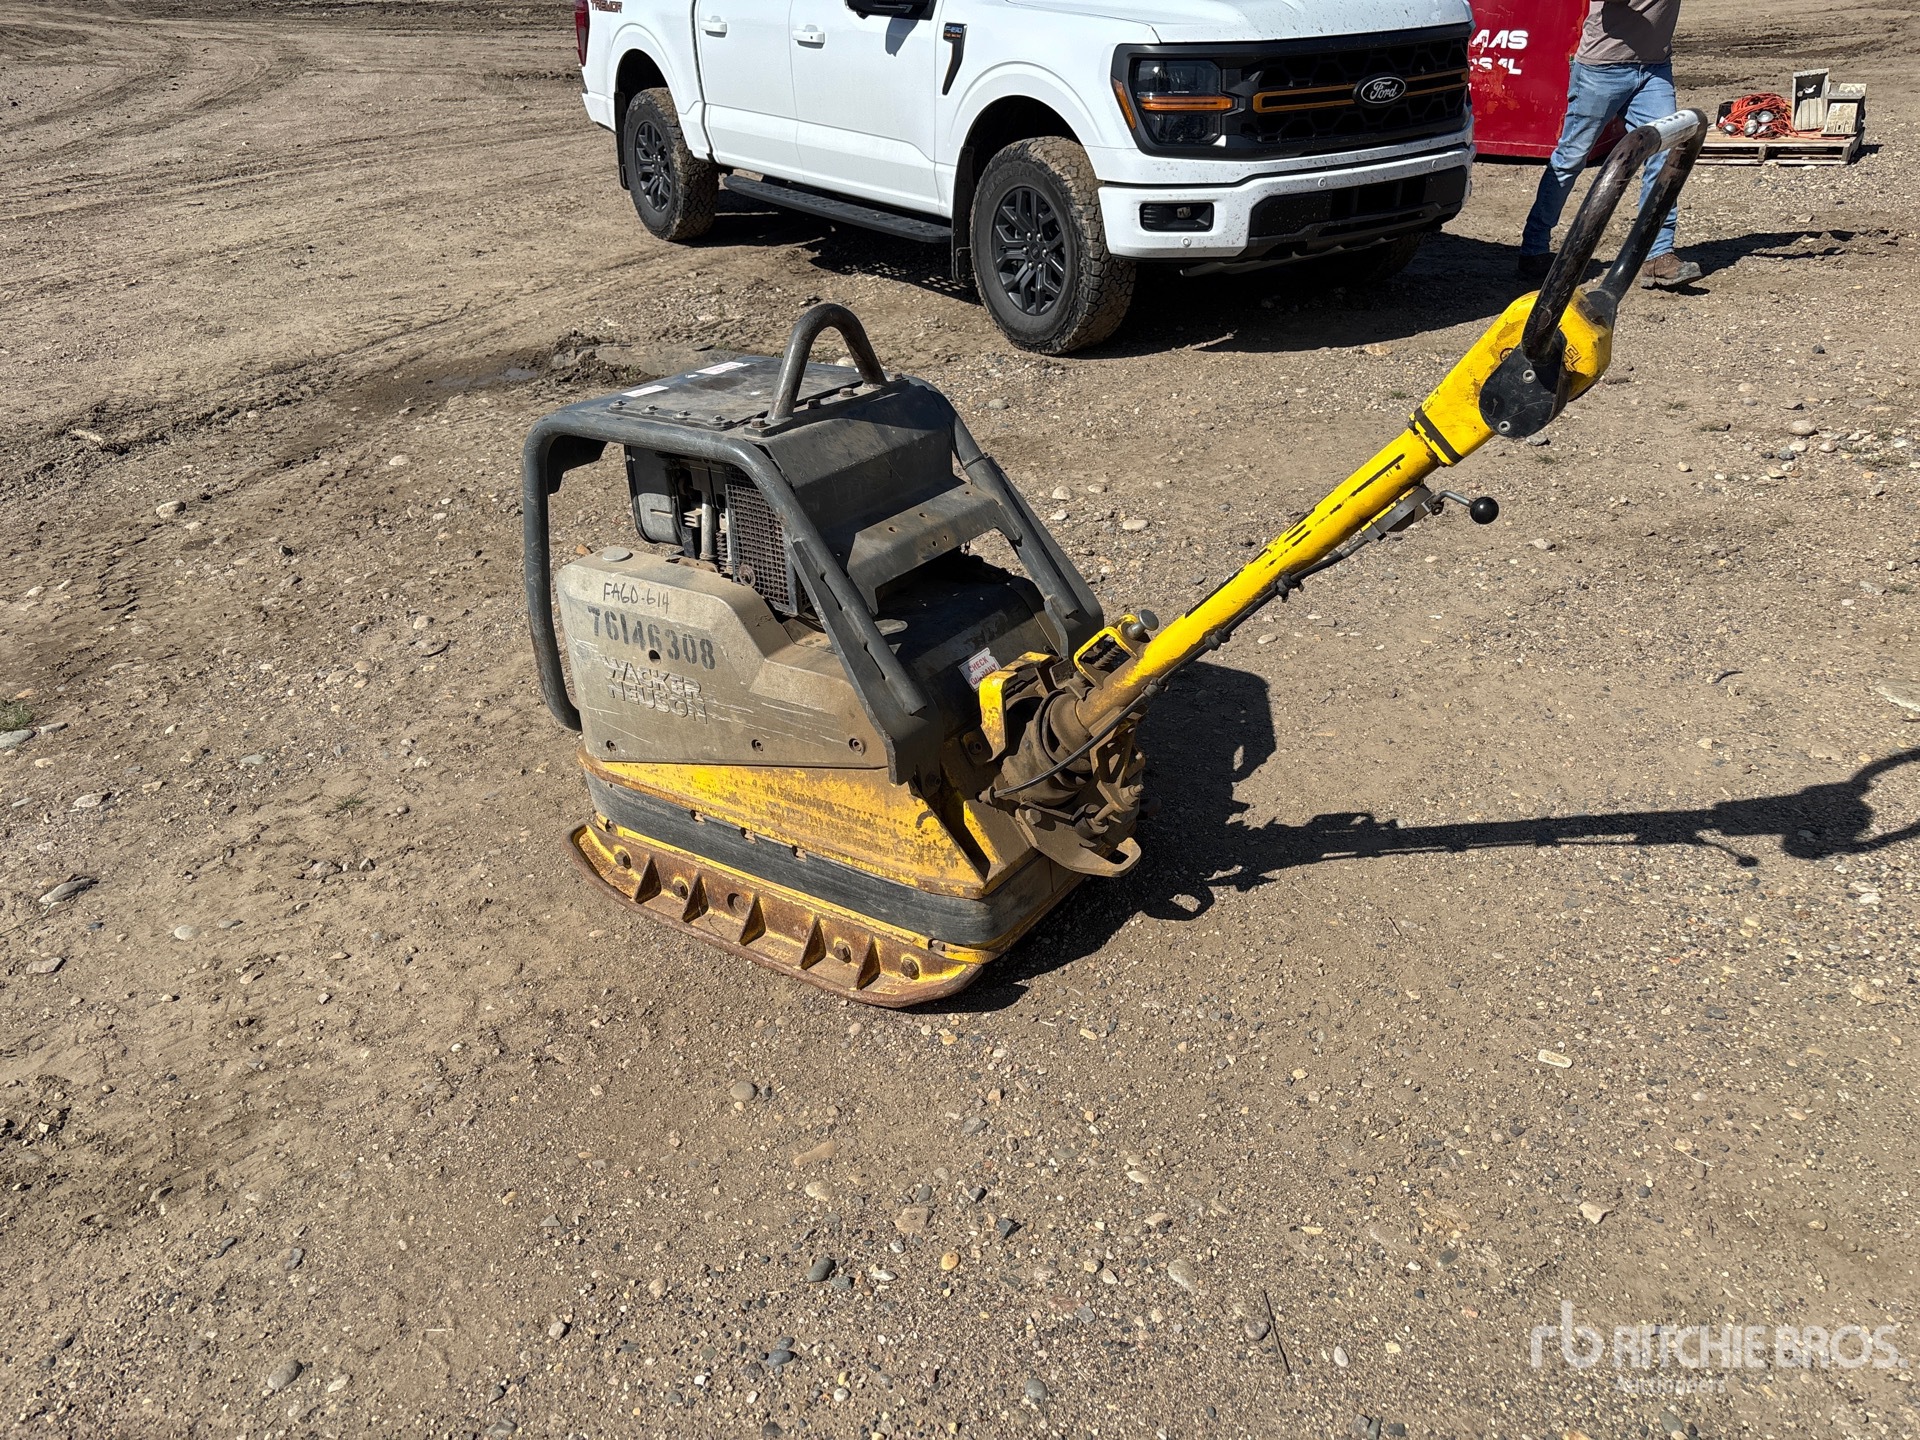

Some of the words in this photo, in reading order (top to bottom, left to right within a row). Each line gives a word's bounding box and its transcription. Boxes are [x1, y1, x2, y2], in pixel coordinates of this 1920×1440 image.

[591, 0, 622, 13] TREMOR
[1369, 80, 1398, 100] Ford
[587, 605, 716, 670] 76146308
[602, 655, 704, 701] WACKER
[968, 656, 989, 673] CHECK
[607, 681, 708, 724] NEUSON
